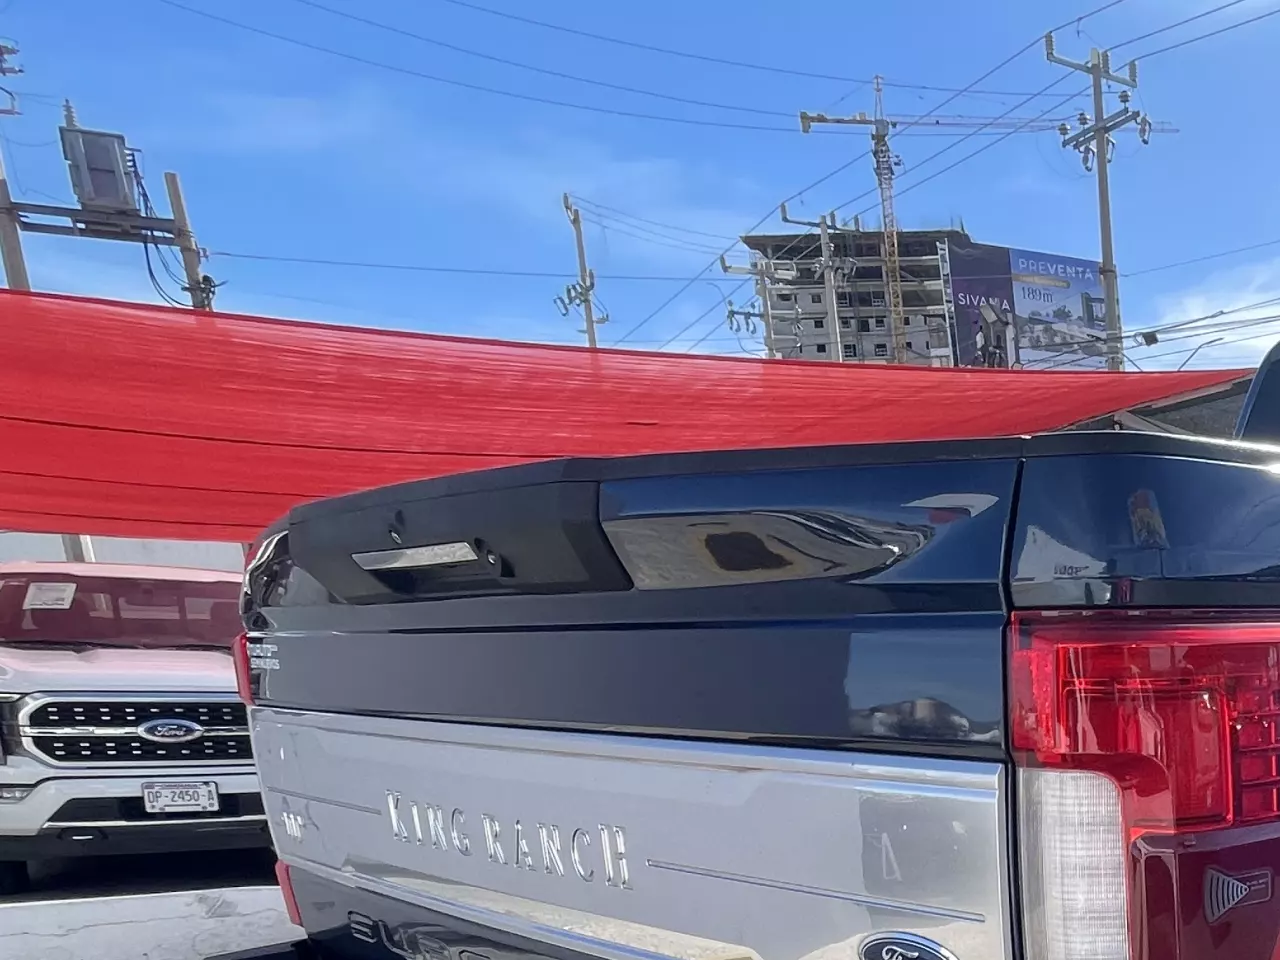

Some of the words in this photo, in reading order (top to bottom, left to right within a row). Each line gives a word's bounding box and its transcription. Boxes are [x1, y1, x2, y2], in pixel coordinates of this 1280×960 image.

[1018, 258, 1095, 281] PREVENTA
[154, 723, 187, 737] Ford
[147, 789, 215, 804] DP-2450-A
[384, 789, 474, 857] KING
[481, 811, 634, 891] RANCH
